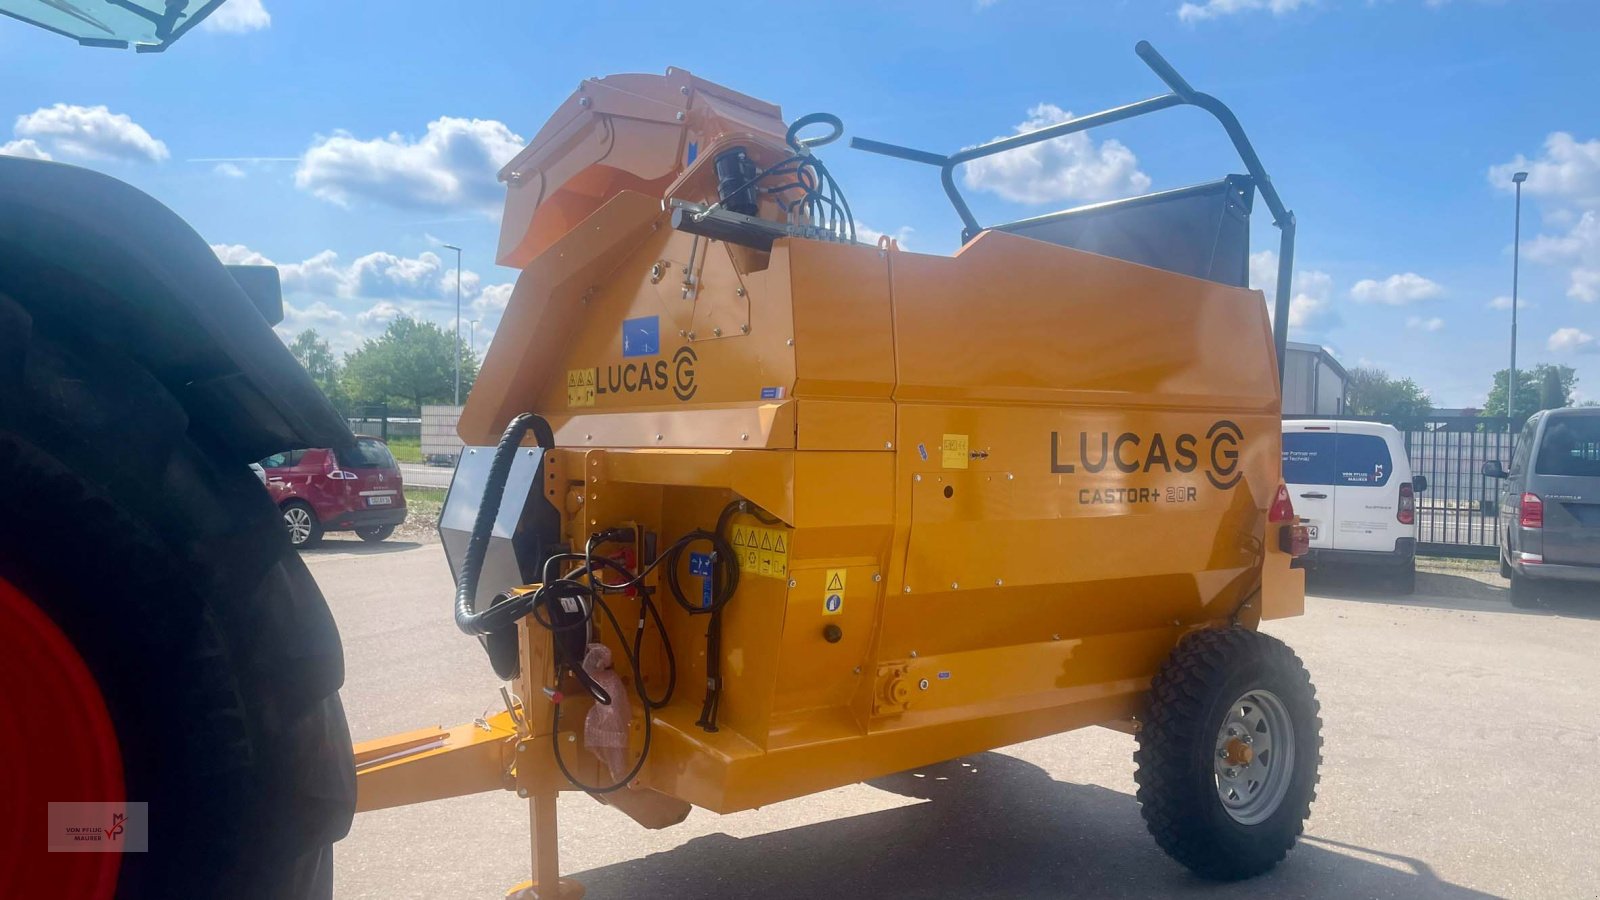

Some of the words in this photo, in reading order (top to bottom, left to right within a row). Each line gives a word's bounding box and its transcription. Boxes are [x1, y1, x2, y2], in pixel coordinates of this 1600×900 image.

[596, 360, 668, 394] LUCAS
[1050, 431, 1198, 474] LUCAS
[1078, 487, 1161, 505] CASTOR+
[1165, 486, 1197, 503] 20R
